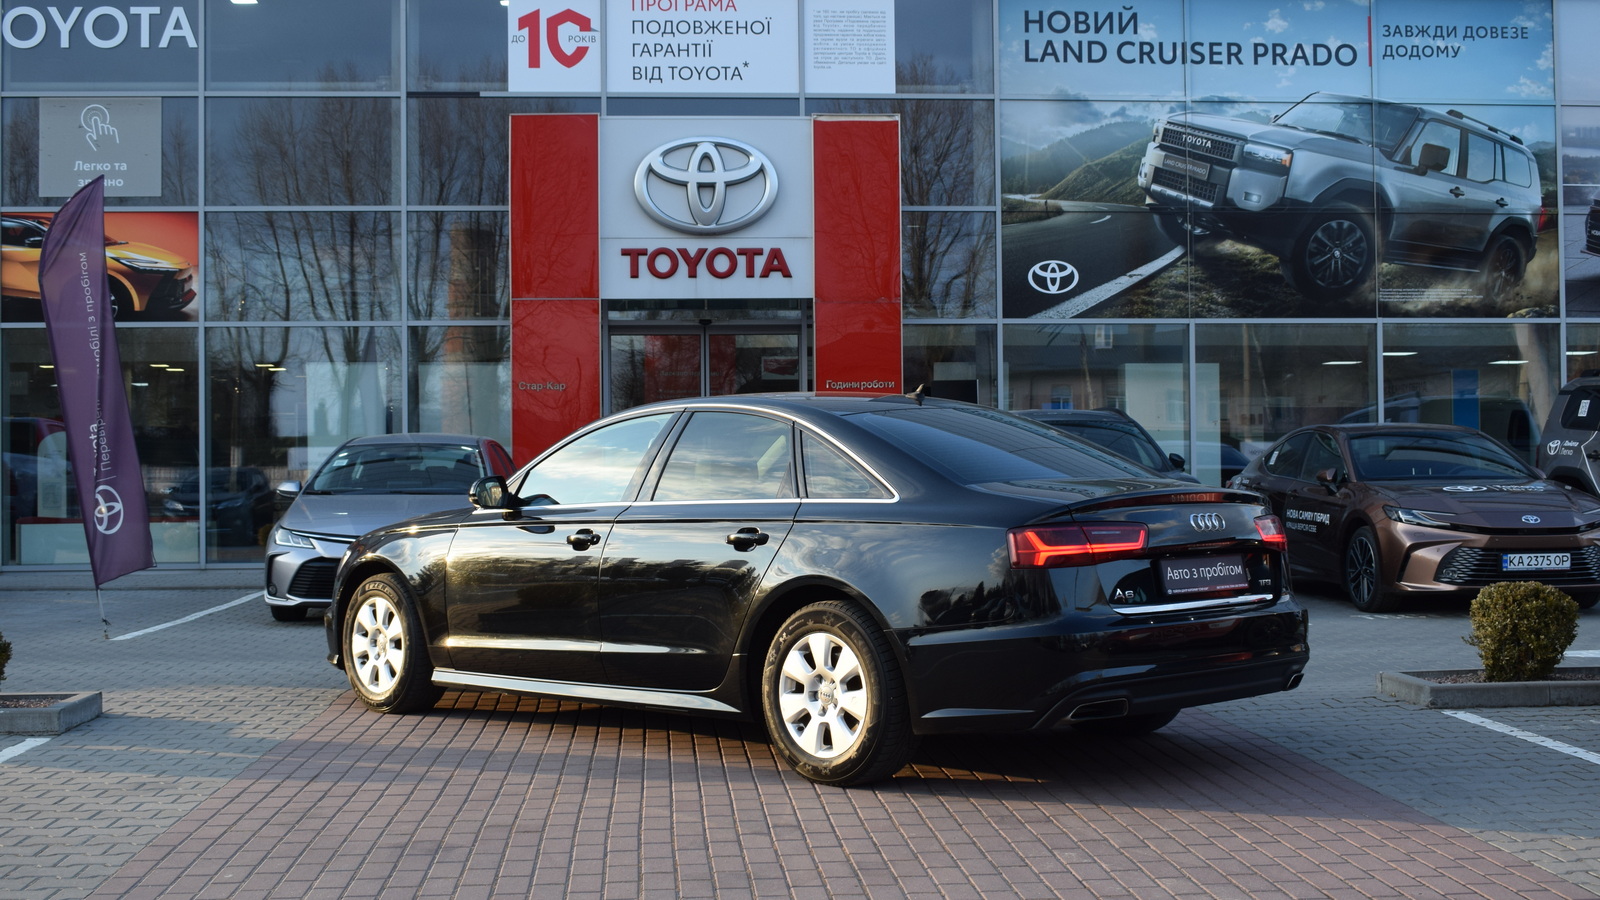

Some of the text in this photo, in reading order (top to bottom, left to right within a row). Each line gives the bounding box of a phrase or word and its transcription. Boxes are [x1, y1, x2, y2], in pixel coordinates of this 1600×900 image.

[631, 0, 737, 12] ПРОГРАМА
[632, 17, 772, 37] ПОДОВЖЕНОЇ
[1024, 5, 1138, 35] НОВИЙ
[511, 35, 526, 44] ДО
[568, 35, 597, 44] РОКІВ
[1382, 25, 1529, 41] ЗАВЖДИ ДОВЕЗЕ
[632, 40, 713, 58] ГАРАНТІЇ
[1024, 40, 1358, 67] LAND CRUISER PRADO
[1382, 45, 1461, 60] ДОДОМУ
[632, 66, 663, 84] ВІД
[1182, 134, 1212, 148] TOYOTA
[74, 161, 127, 171] Легко та
[621, 247, 793, 279] TOYOTA
[79, 252, 95, 312] пробігом
[518, 382, 566, 392] Стар-Кар
[826, 380, 895, 390] Години роботи
[1509, 555, 1569, 567] KA 2375 OP
[1167, 562, 1243, 581] Авто з пробігом
[1114, 588, 1134, 600] A6
